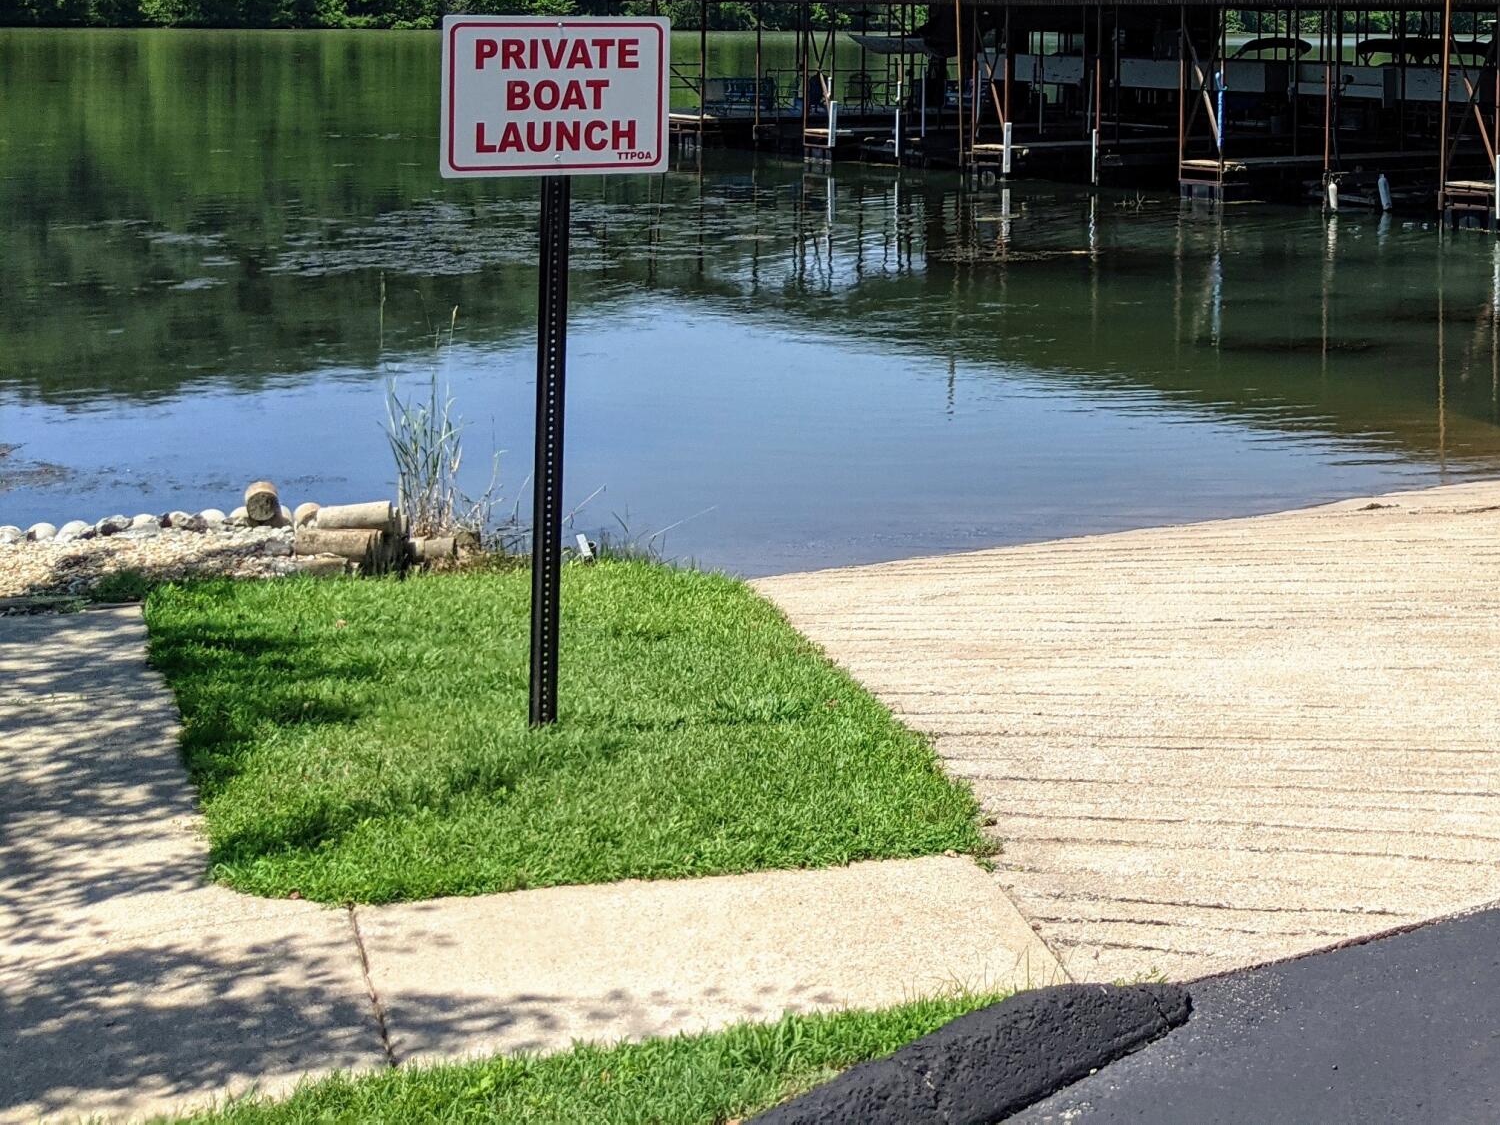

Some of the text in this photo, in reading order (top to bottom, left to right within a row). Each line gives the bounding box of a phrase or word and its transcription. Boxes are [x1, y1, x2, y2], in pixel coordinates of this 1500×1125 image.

[475, 38, 639, 69] PRIVATE
[506, 79, 610, 111] BOAT
[475, 120, 636, 153] LAUNCH
[616, 151, 652, 160] TTPOA
